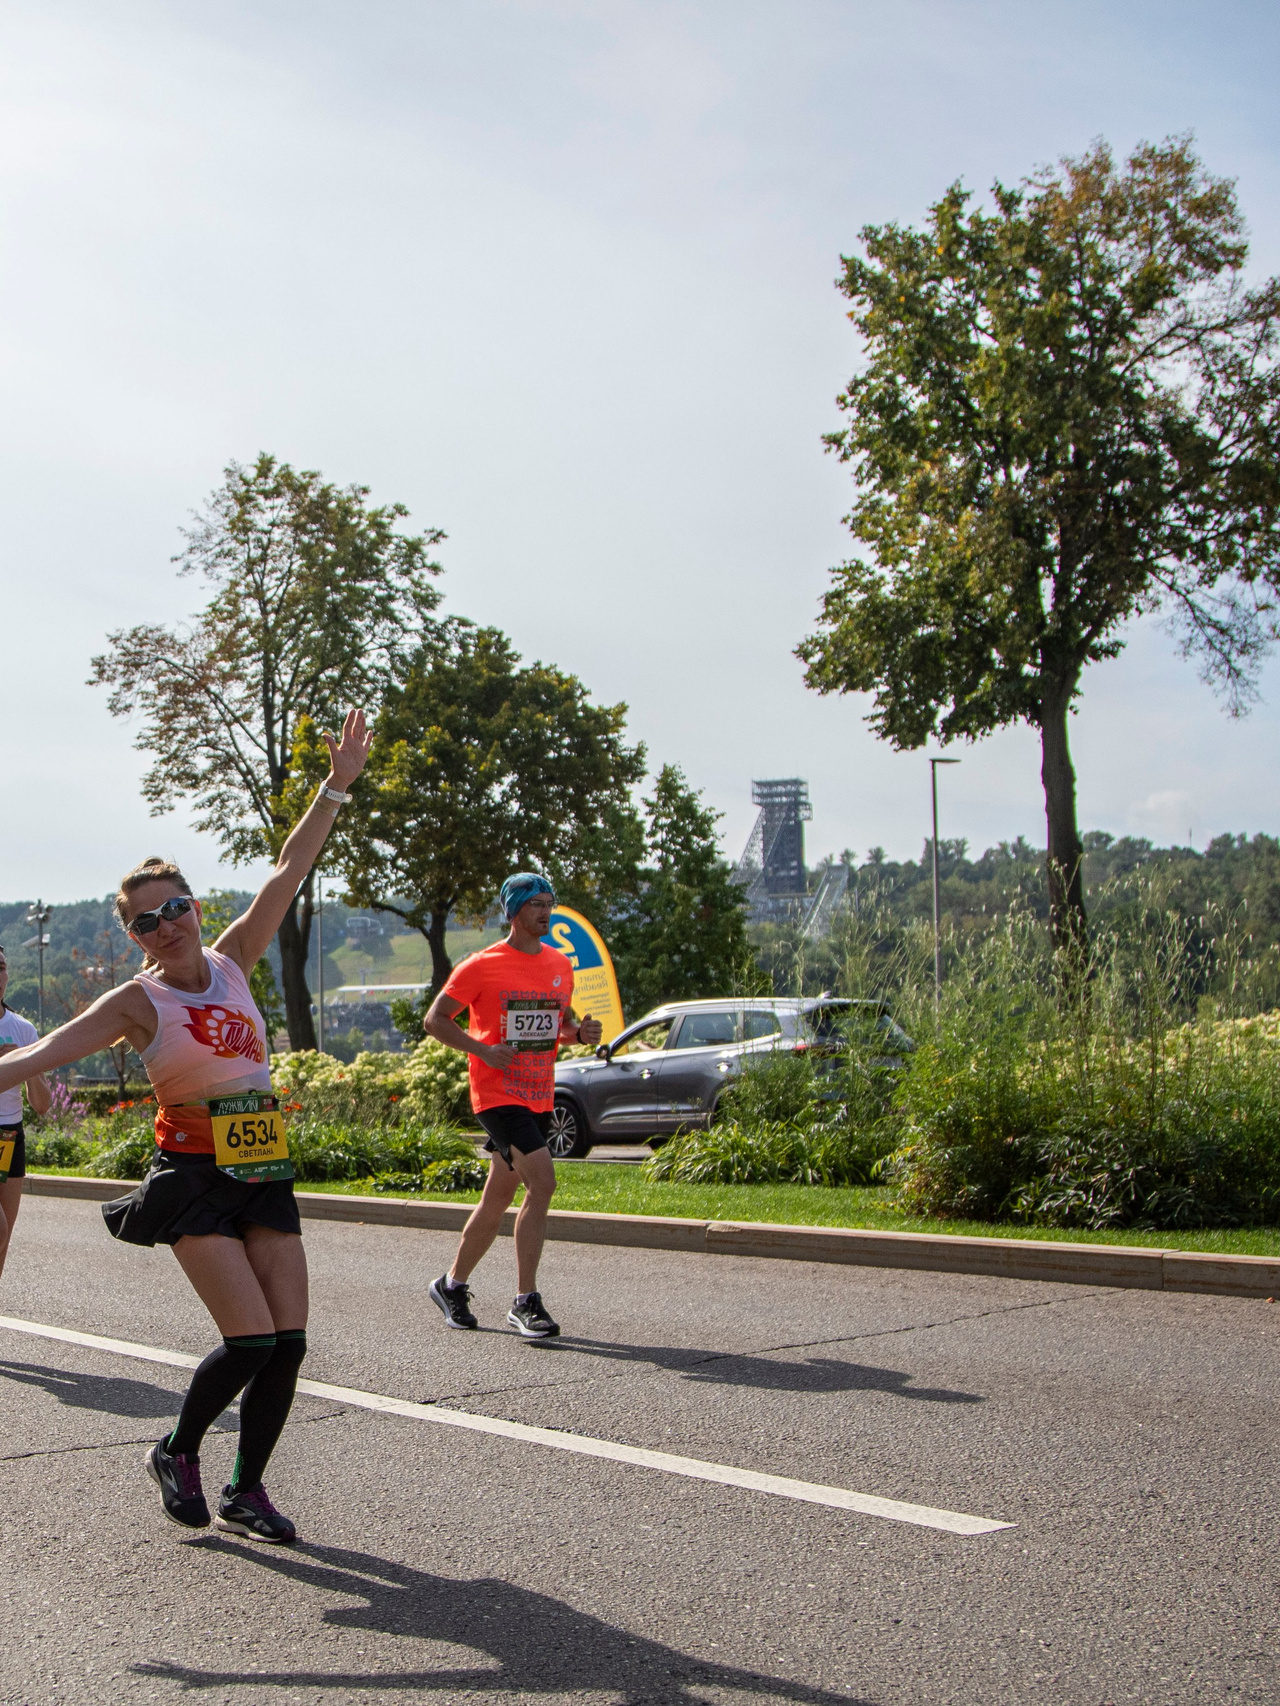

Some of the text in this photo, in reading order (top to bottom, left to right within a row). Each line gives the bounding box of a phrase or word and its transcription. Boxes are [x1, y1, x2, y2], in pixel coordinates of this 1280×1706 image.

[515, 1014, 553, 1031] 5723
[226, 1119, 278, 1148] 6534
[239, 1148, 274, 1158] СВЕТЛАНА
